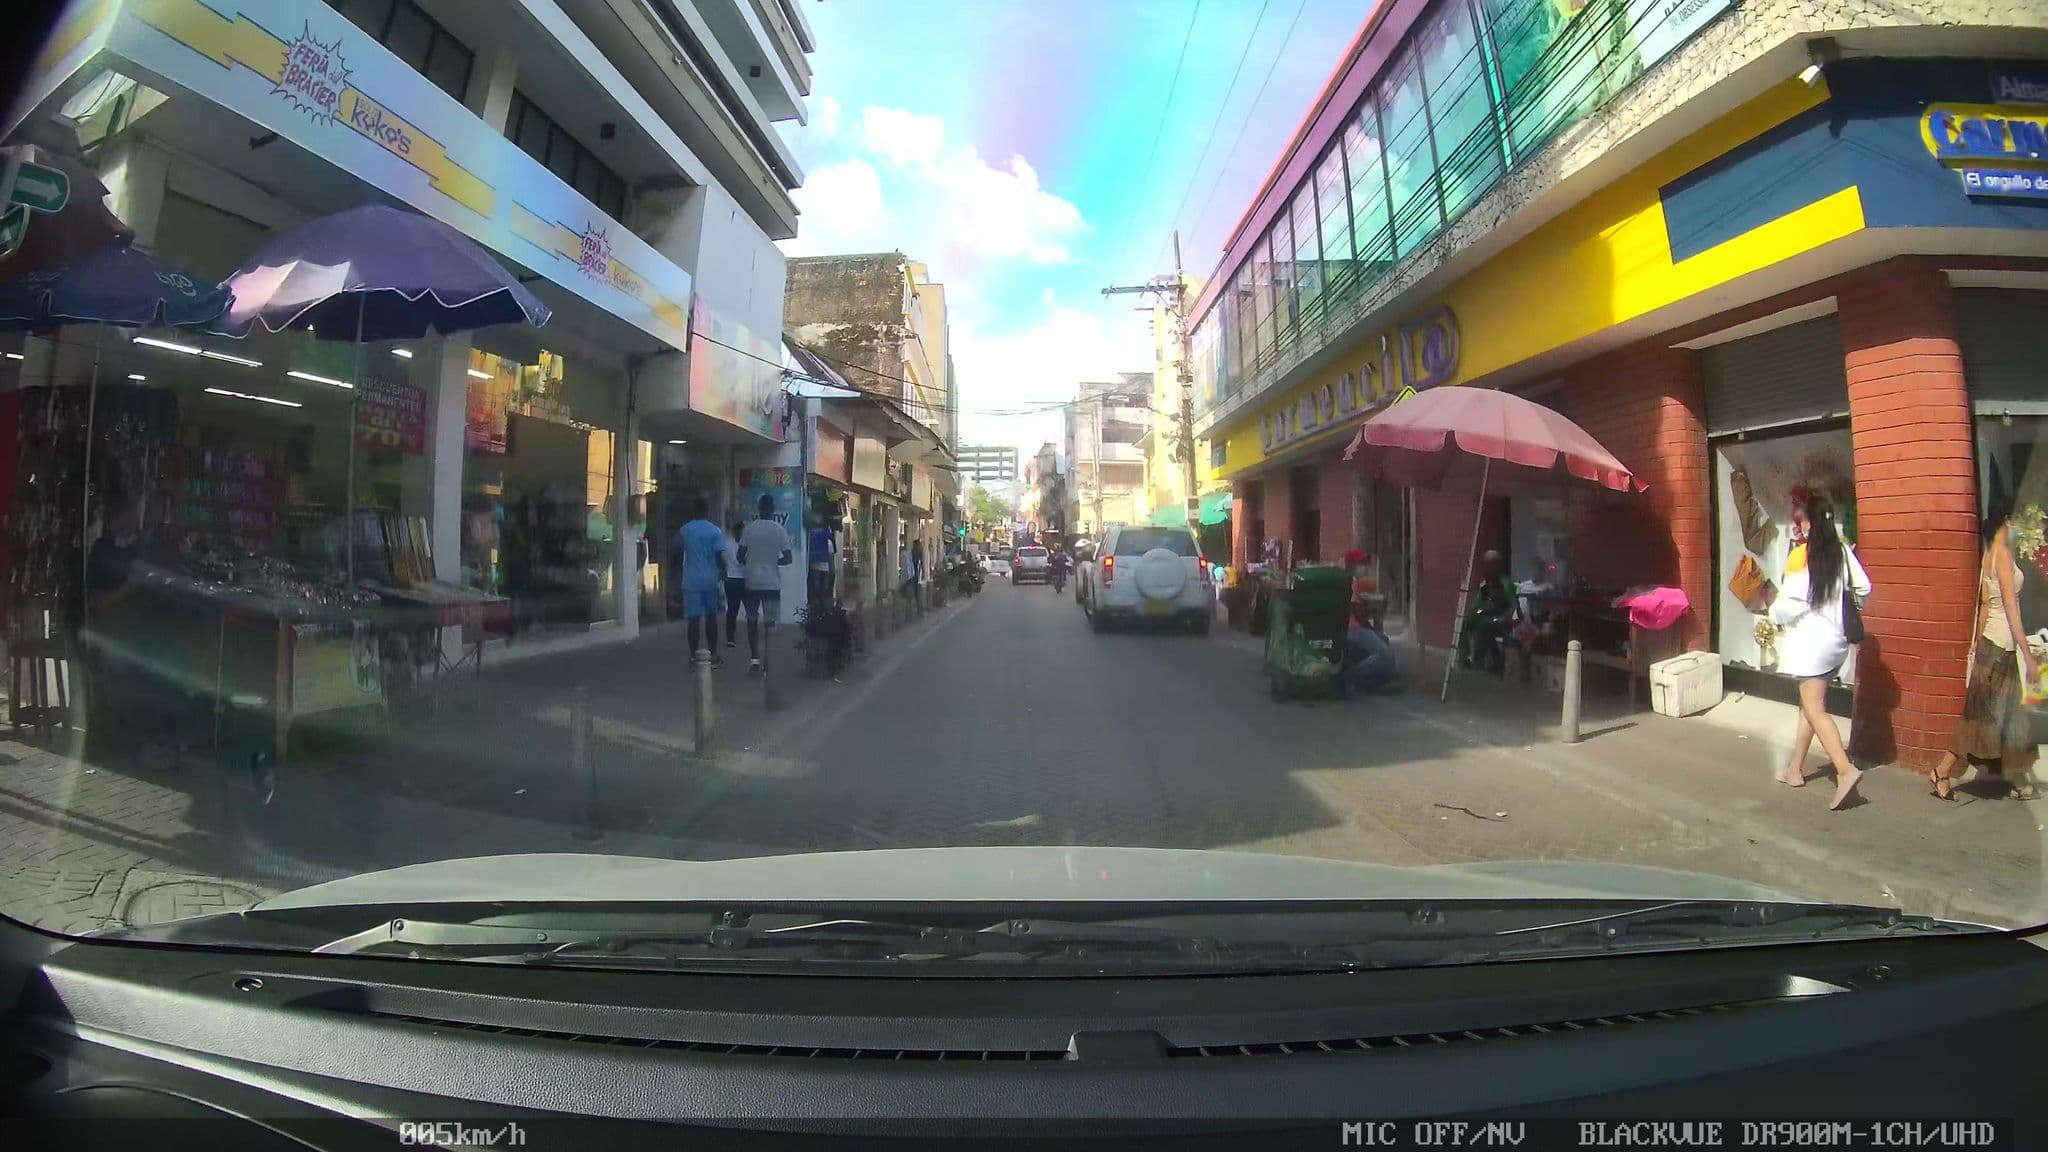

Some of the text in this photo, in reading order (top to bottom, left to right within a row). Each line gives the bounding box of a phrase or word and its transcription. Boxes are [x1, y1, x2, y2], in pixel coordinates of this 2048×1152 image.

[293, 43, 329, 78] FERIA
[1966, 172, 1981, 187] El
[1984, 174, 2032, 191] orgullo
